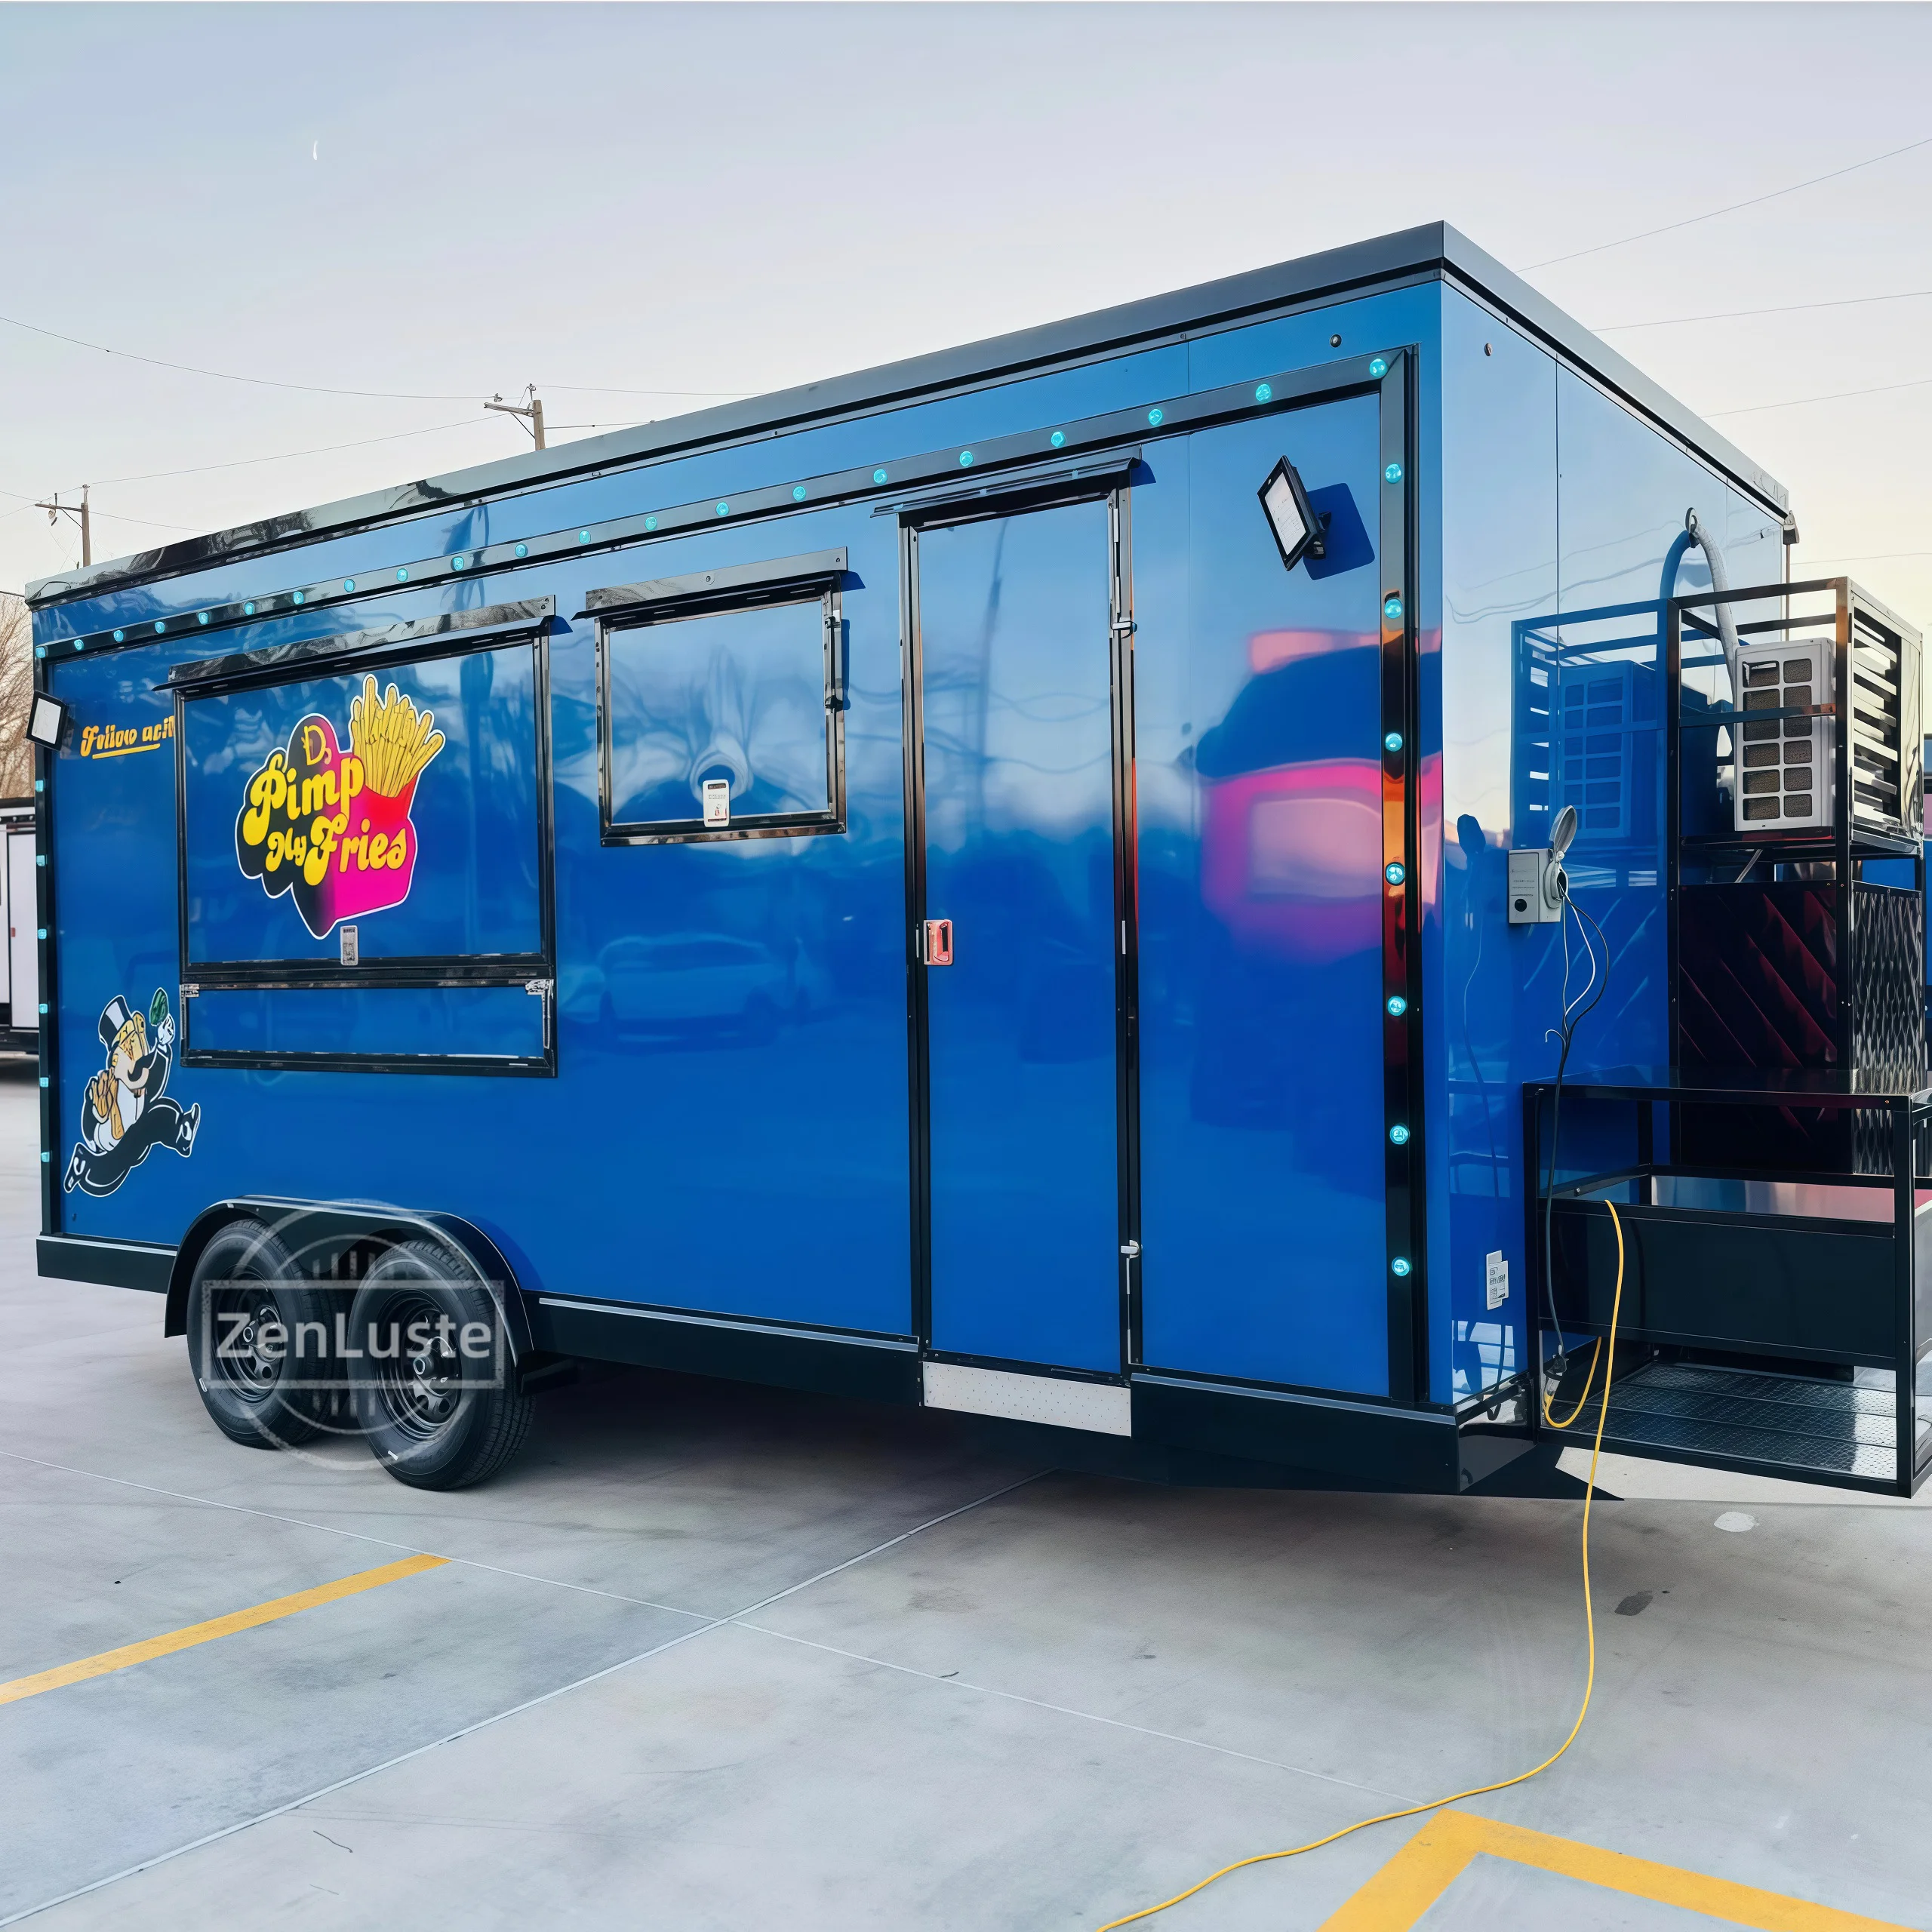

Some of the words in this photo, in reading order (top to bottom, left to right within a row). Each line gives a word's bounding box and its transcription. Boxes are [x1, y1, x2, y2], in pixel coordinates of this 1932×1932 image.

[242, 753, 365, 846] Pimp
[266, 827, 307, 872] My
[303, 813, 407, 886] Fries
